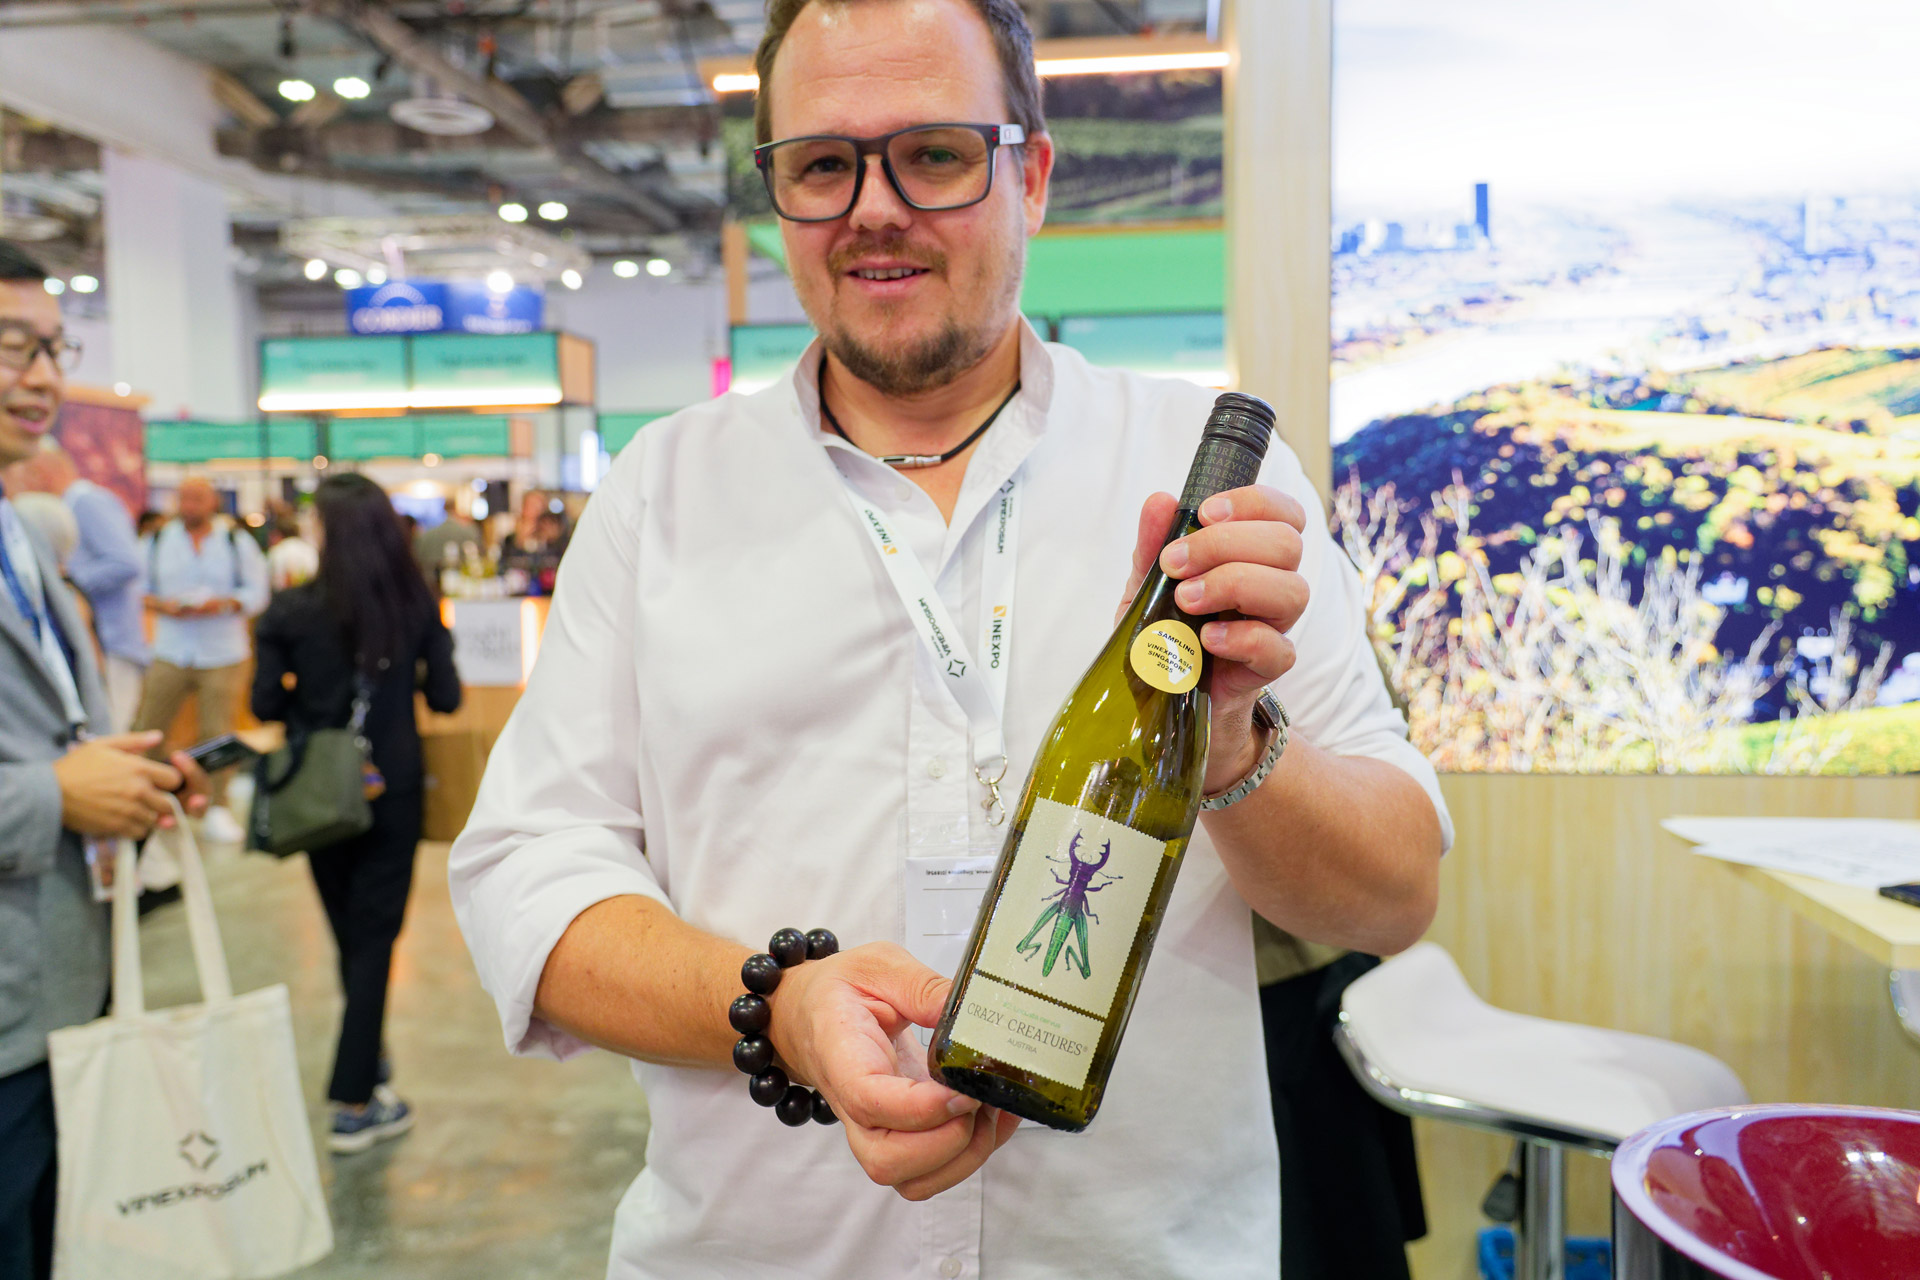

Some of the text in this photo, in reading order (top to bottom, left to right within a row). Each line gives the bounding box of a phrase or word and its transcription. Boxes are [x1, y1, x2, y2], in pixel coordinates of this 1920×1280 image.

[1204, 456, 1238, 470] CRAZY
[1197, 476, 1231, 491] CRAZY
[918, 598, 952, 656] VINEXPOSIUM
[1157, 631, 1195, 656] SAMPLING
[1147, 642, 1192, 671] VINEXPO ASIA
[1147, 650, 1187, 674] SINGAPORE
[1157, 662, 1173, 673] 2025
[967, 1002, 1004, 1026] CRAZY
[1008, 1038, 1038, 1054] AUSTRIA
